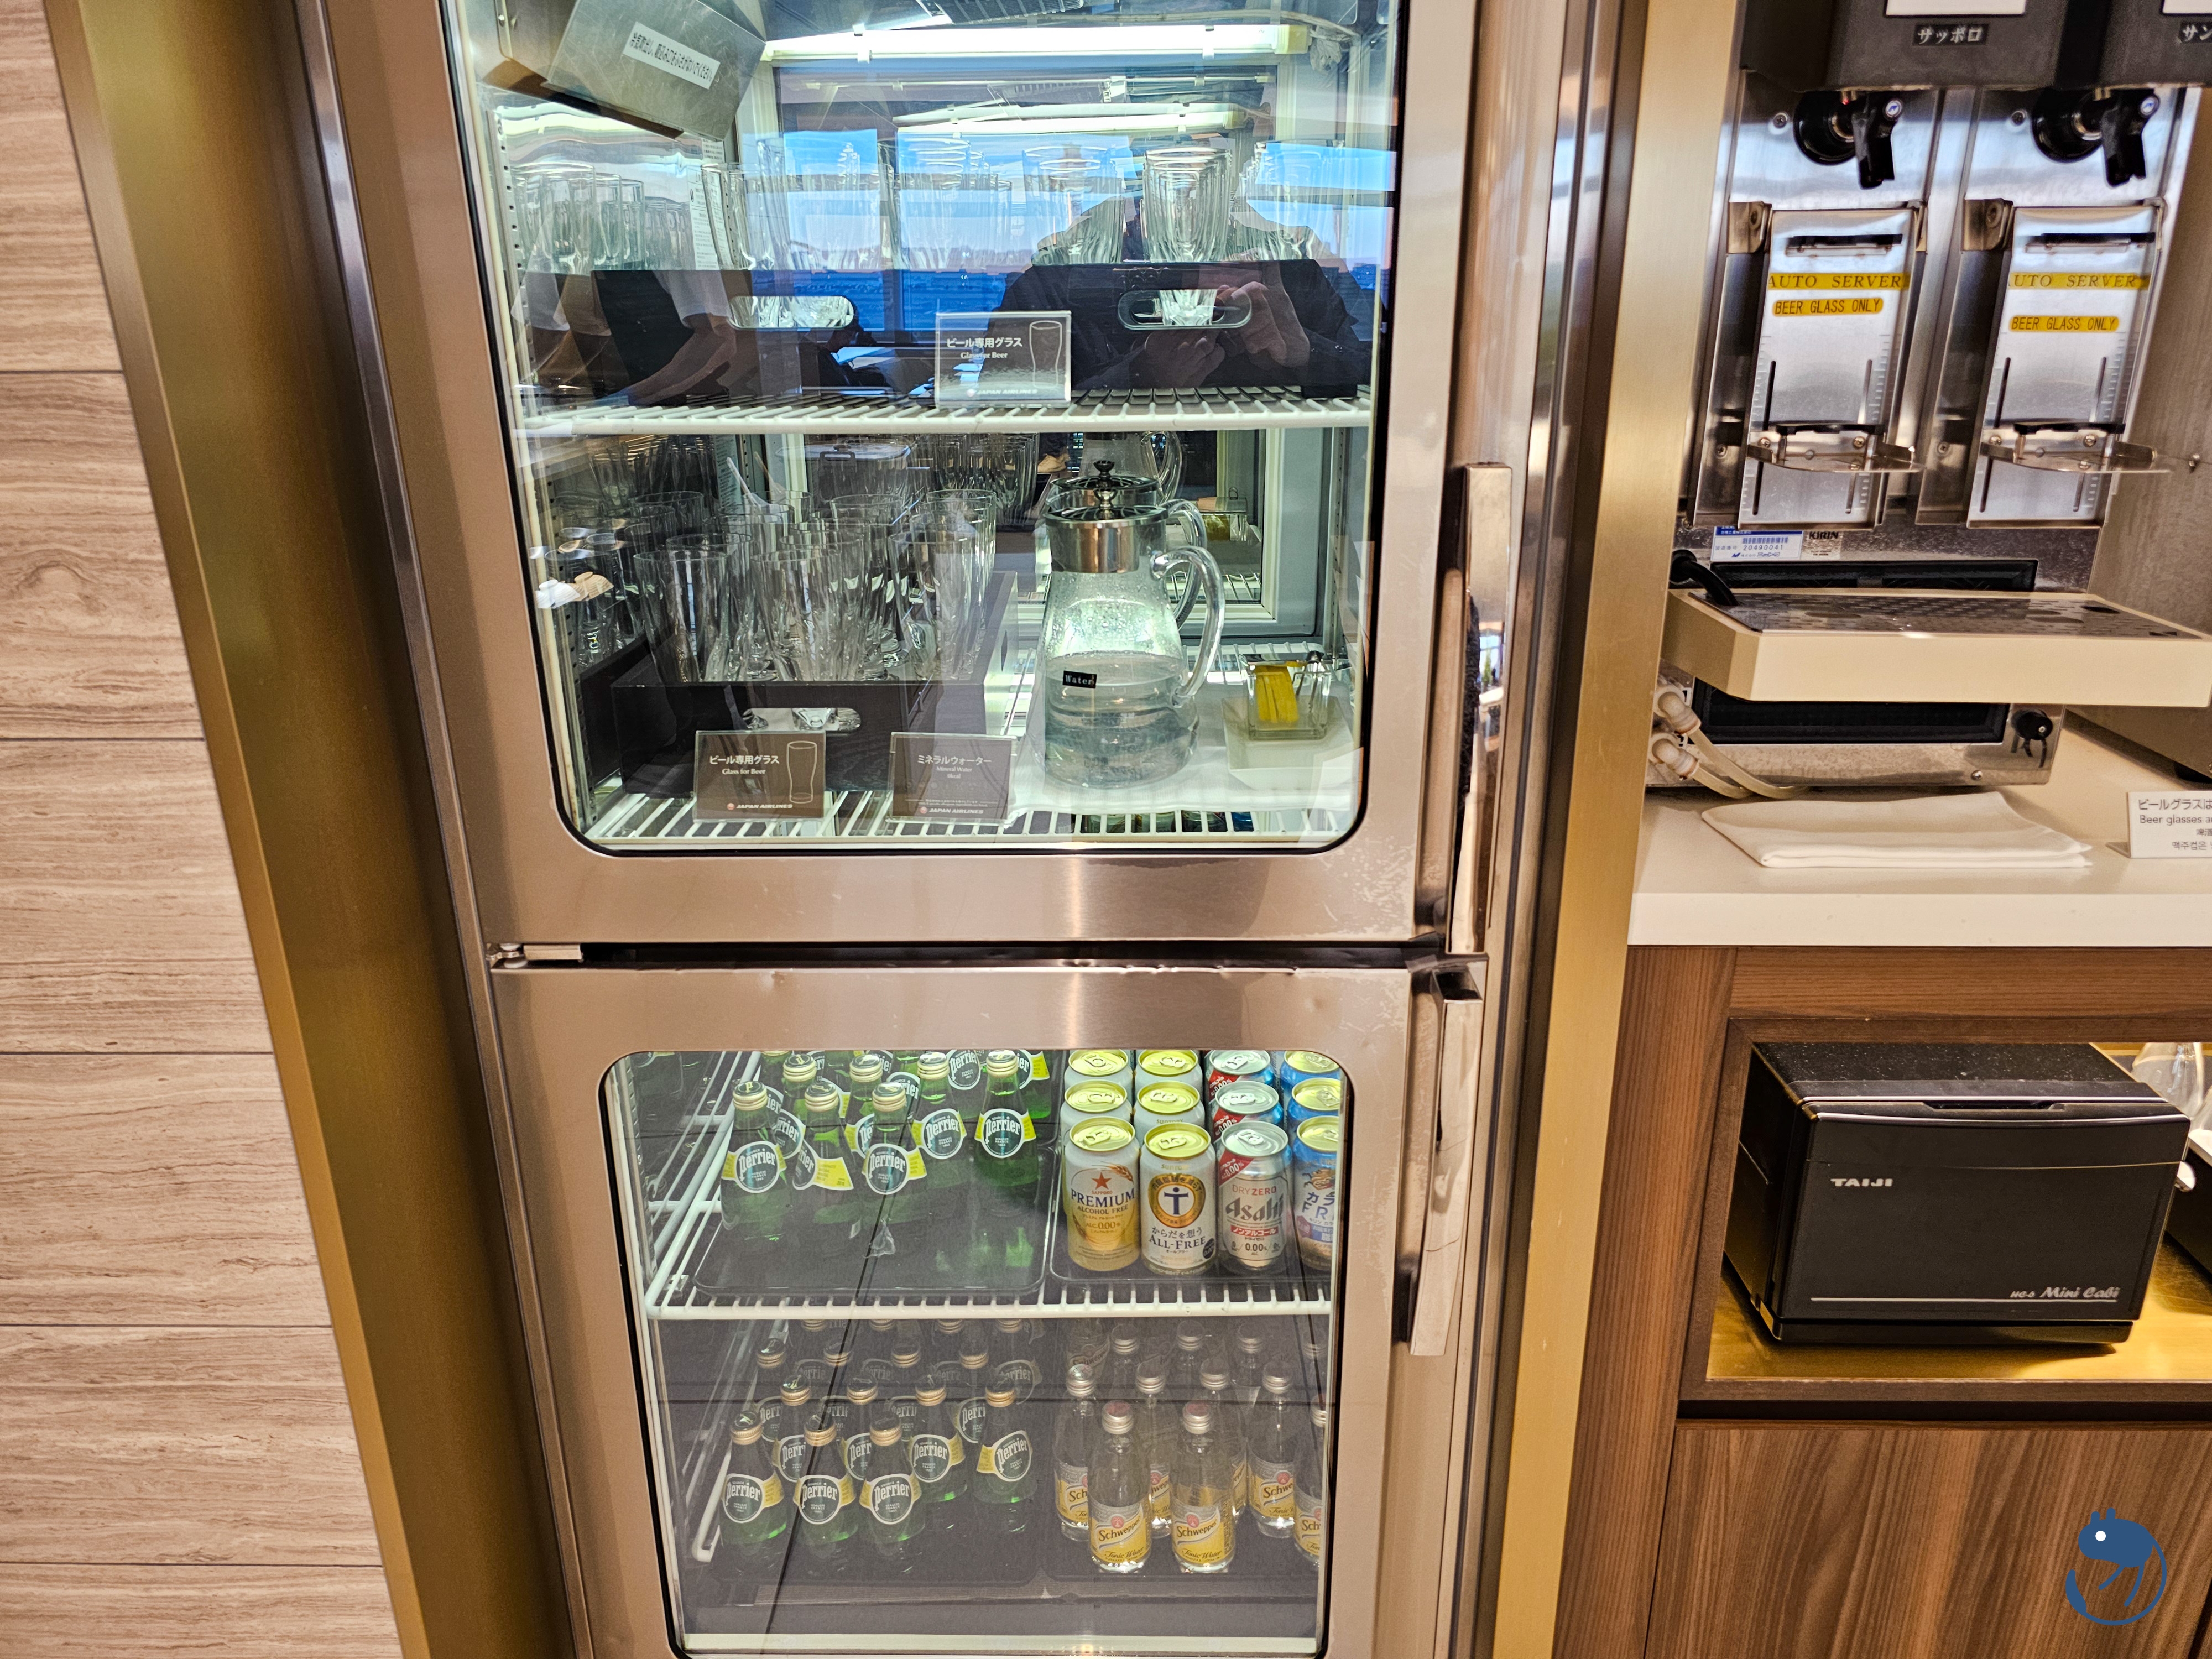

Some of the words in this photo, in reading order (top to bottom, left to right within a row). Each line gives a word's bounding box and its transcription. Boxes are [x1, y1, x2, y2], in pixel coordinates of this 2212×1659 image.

[1917, 26, 1983, 44] サッポロ
[1832, 275, 1902, 288] SERVER
[2009, 275, 2052, 287] UTO
[2066, 275, 2136, 288] SERVER
[1774, 300, 1803, 315] BEER
[1810, 300, 1845, 314] GLASS
[1852, 299, 1880, 312] ONLY
[2011, 317, 2040, 330] BEER
[2046, 317, 2081, 330] GLASS
[2087, 317, 2116, 330] ONLY
[947, 337, 1023, 348] ビール専用グラス
[1809, 531, 1839, 540] KIRIN
[1065, 675, 1092, 685] Water
[709, 755, 780, 765] ビール専用グラス
[917, 755, 992, 765] ミネラルウォーター
[2138, 798, 2212, 810] ビールグラスは
[2140, 815, 2163, 823] Beer
[2166, 814, 2202, 826] glasses
[2172, 841, 2207, 850] 맥주컵은
[1830, 1178, 1893, 1187] TAIJI
[1071, 1188, 1135, 1208] PREMIUM
[1077, 1206, 1109, 1215] ALCOHOL
[1112, 1204, 1129, 1214] FREE
[1225, 1193, 1284, 1222] Asahi
[1302, 1201, 1334, 1220] FR
[1151, 1225, 1202, 1239] からだを想う
[1232, 1227, 1276, 1236] ノンアルコール
[1149, 1234, 1206, 1250] ALL-FREE
[2039, 1286, 2081, 1298] Mini
[2083, 1286, 2121, 1298] Cabi
[1263, 1482, 1293, 1499] Schwe
[1177, 1519, 1217, 1537] Schweppes
[1182, 1548, 1201, 1558] Tonic
